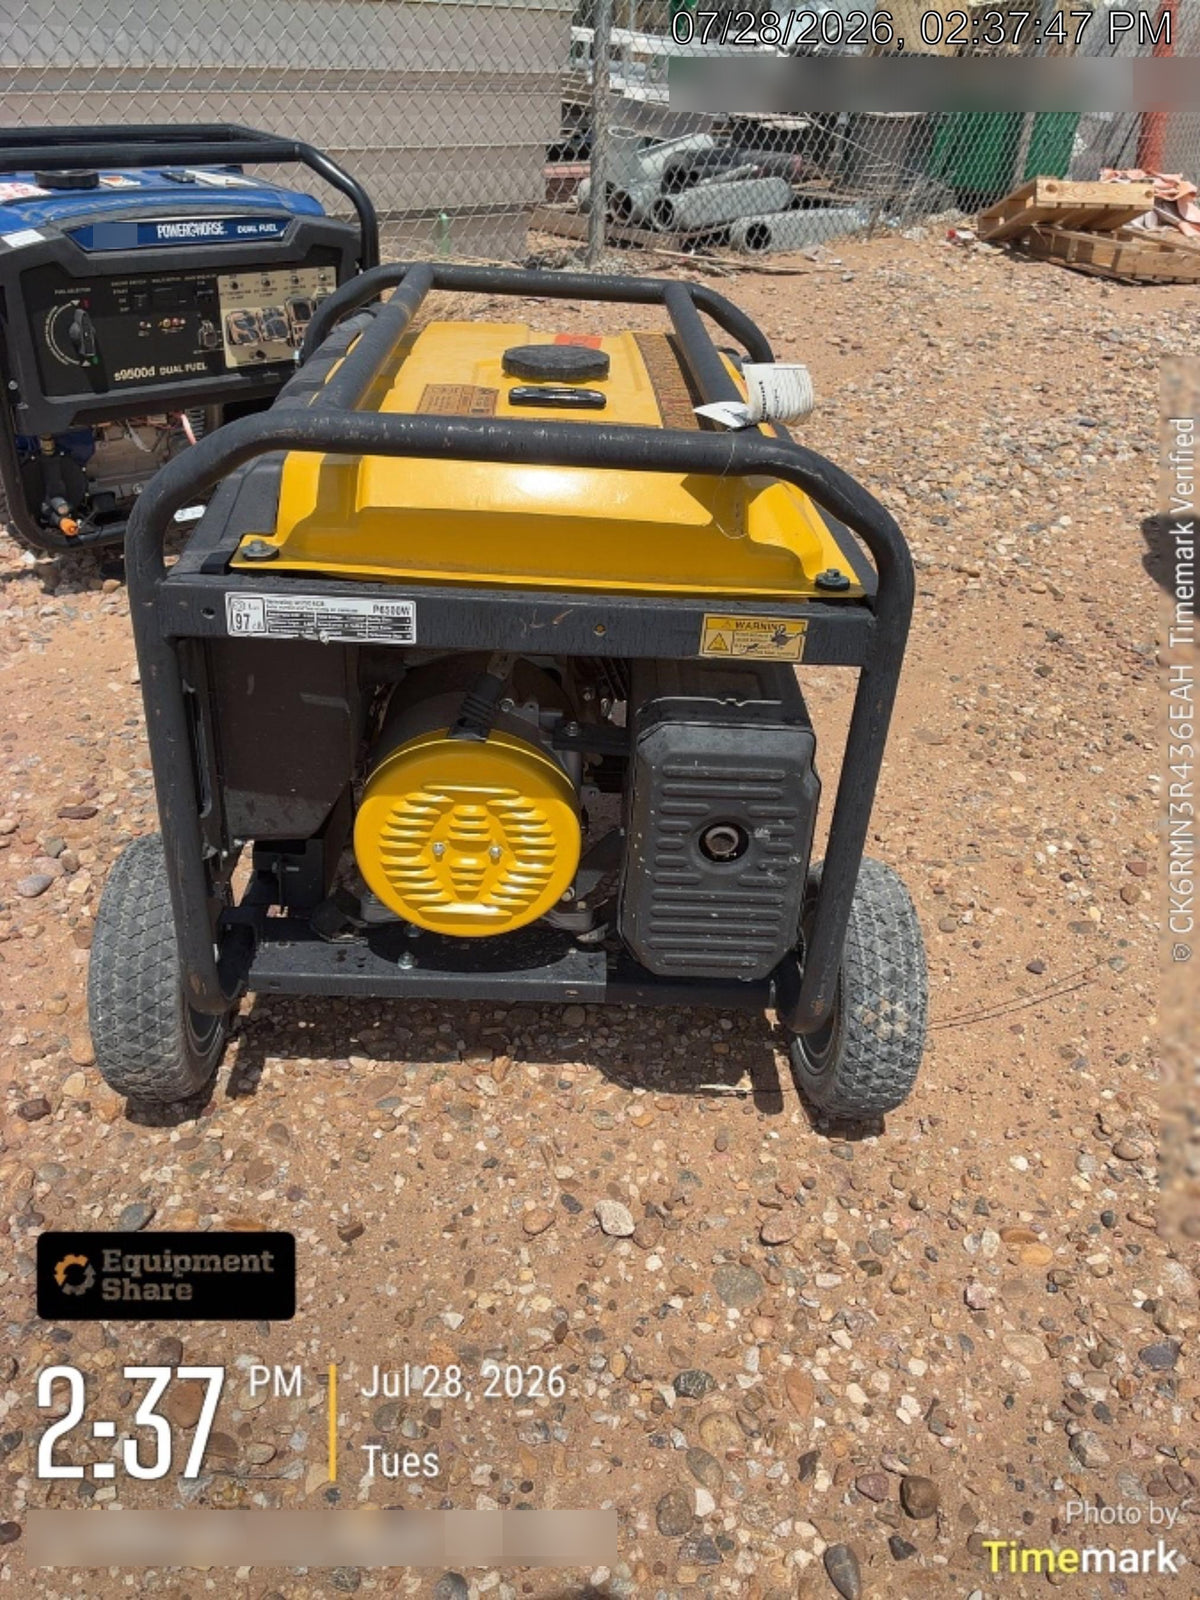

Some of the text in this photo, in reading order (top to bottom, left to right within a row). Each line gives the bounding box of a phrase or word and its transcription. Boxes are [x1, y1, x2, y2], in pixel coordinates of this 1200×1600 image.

[259, 223, 279, 232] FUEL
[160, 365, 184, 376] DUAL
[184, 361, 208, 373] FUEL
[235, 613, 250, 630] 97
[735, 621, 787, 631] WARNING
